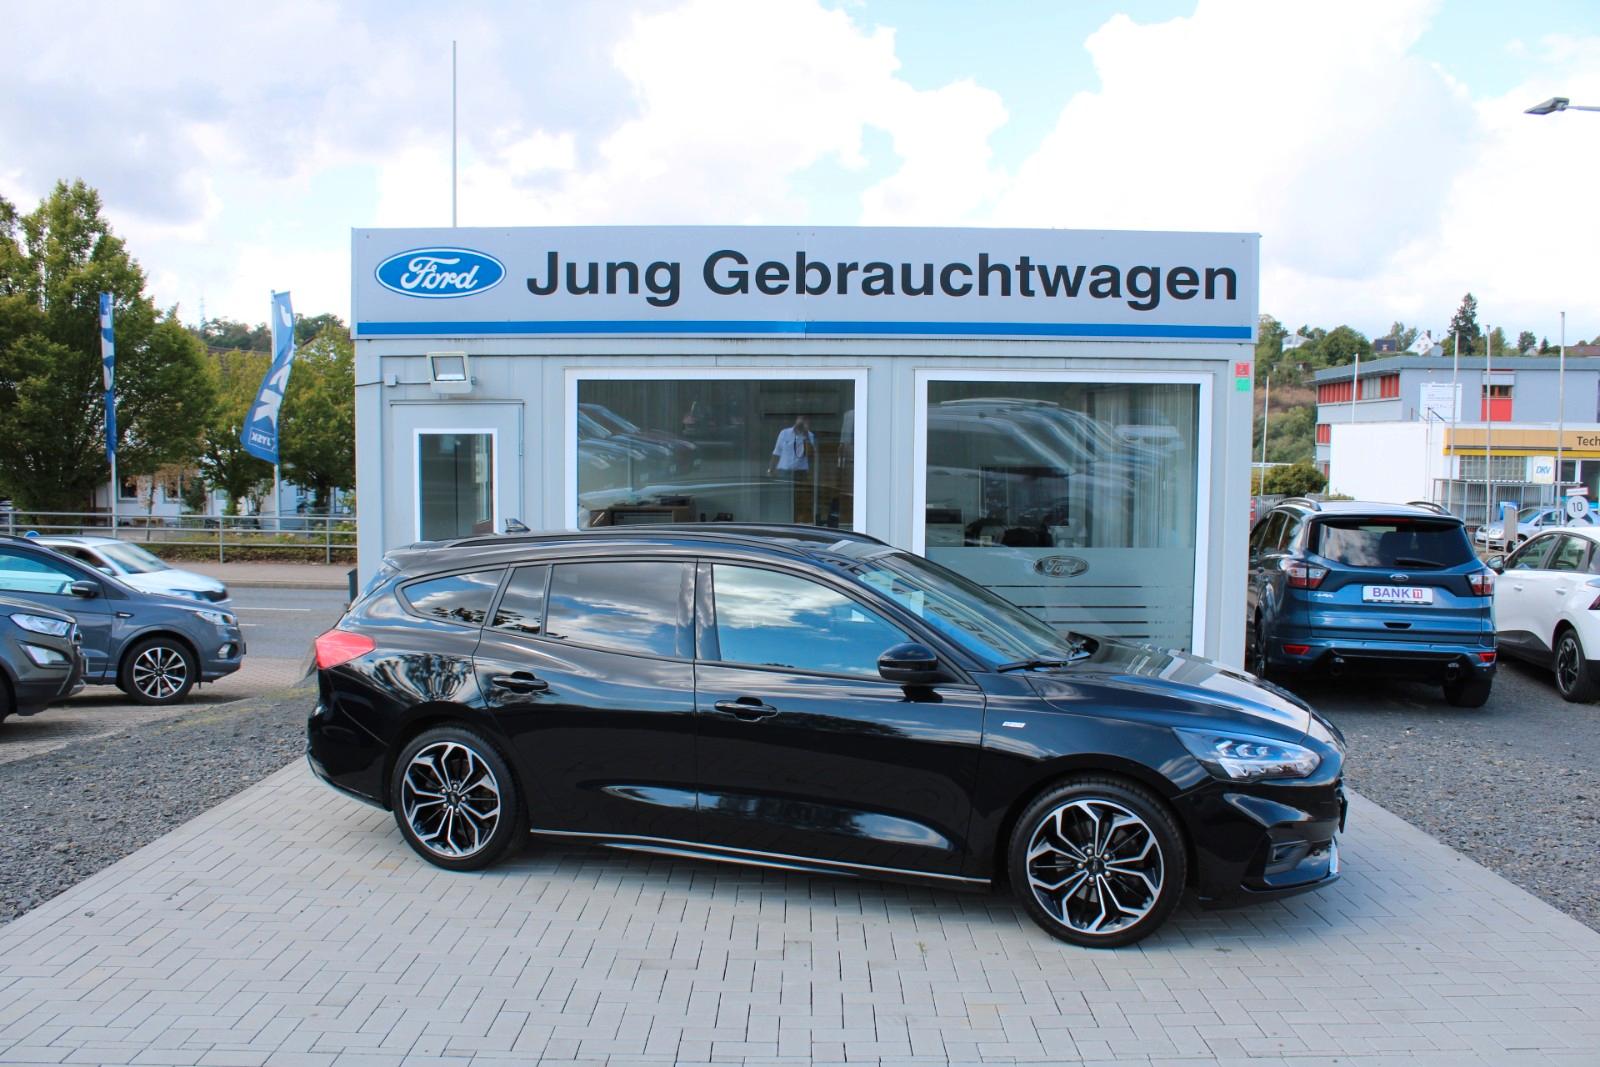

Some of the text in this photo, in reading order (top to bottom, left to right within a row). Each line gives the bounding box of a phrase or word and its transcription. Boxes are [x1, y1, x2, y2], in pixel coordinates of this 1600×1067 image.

[400, 256, 480, 289] Ford
[527, 249, 1237, 311] Jung Gebrauchtwagen
[1576, 435, 1600, 447] Tech
[1536, 465, 1551, 475] DKV
[1572, 502, 1583, 512] 10
[1373, 587, 1410, 599] BANK
